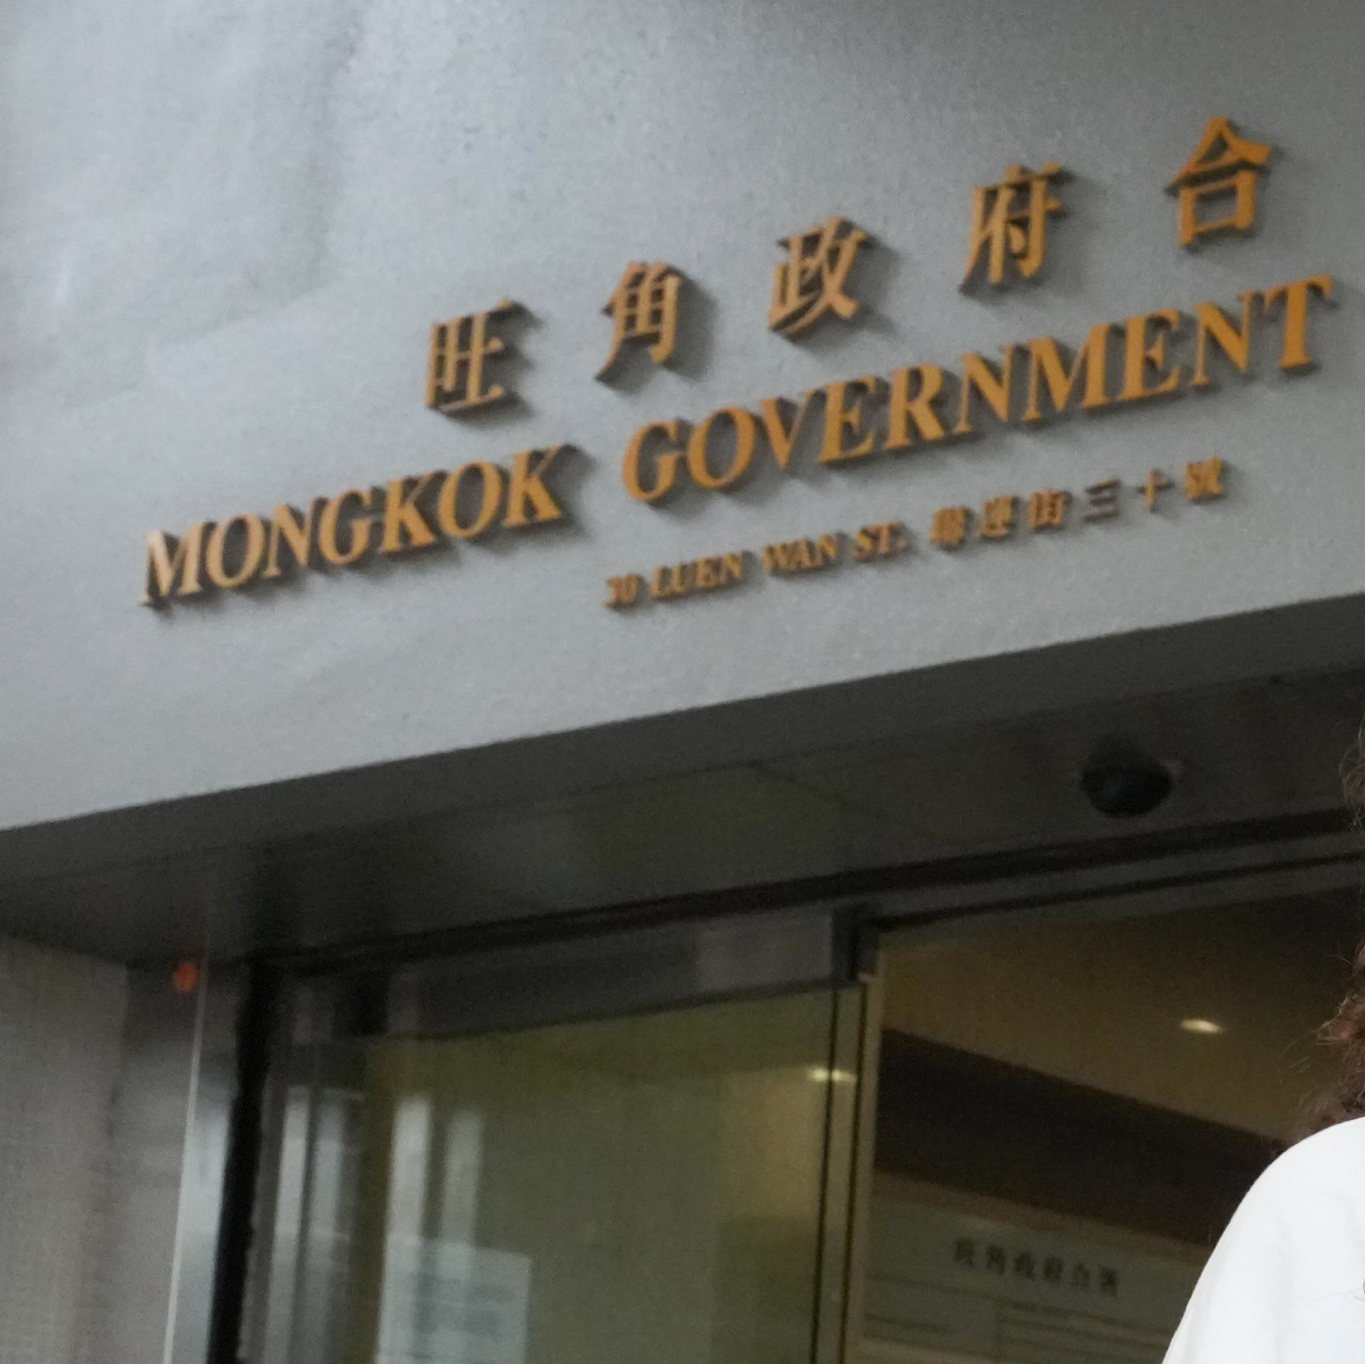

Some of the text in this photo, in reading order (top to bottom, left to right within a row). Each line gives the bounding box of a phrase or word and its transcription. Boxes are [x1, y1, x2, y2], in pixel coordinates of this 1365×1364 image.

[143, 446, 566, 602] MONGKOK
[622, 273, 1334, 504] GOVERNMENT
[649, 553, 745, 600] LUEN
[762, 534, 840, 573] WAN
[853, 522, 908, 562] ST.
